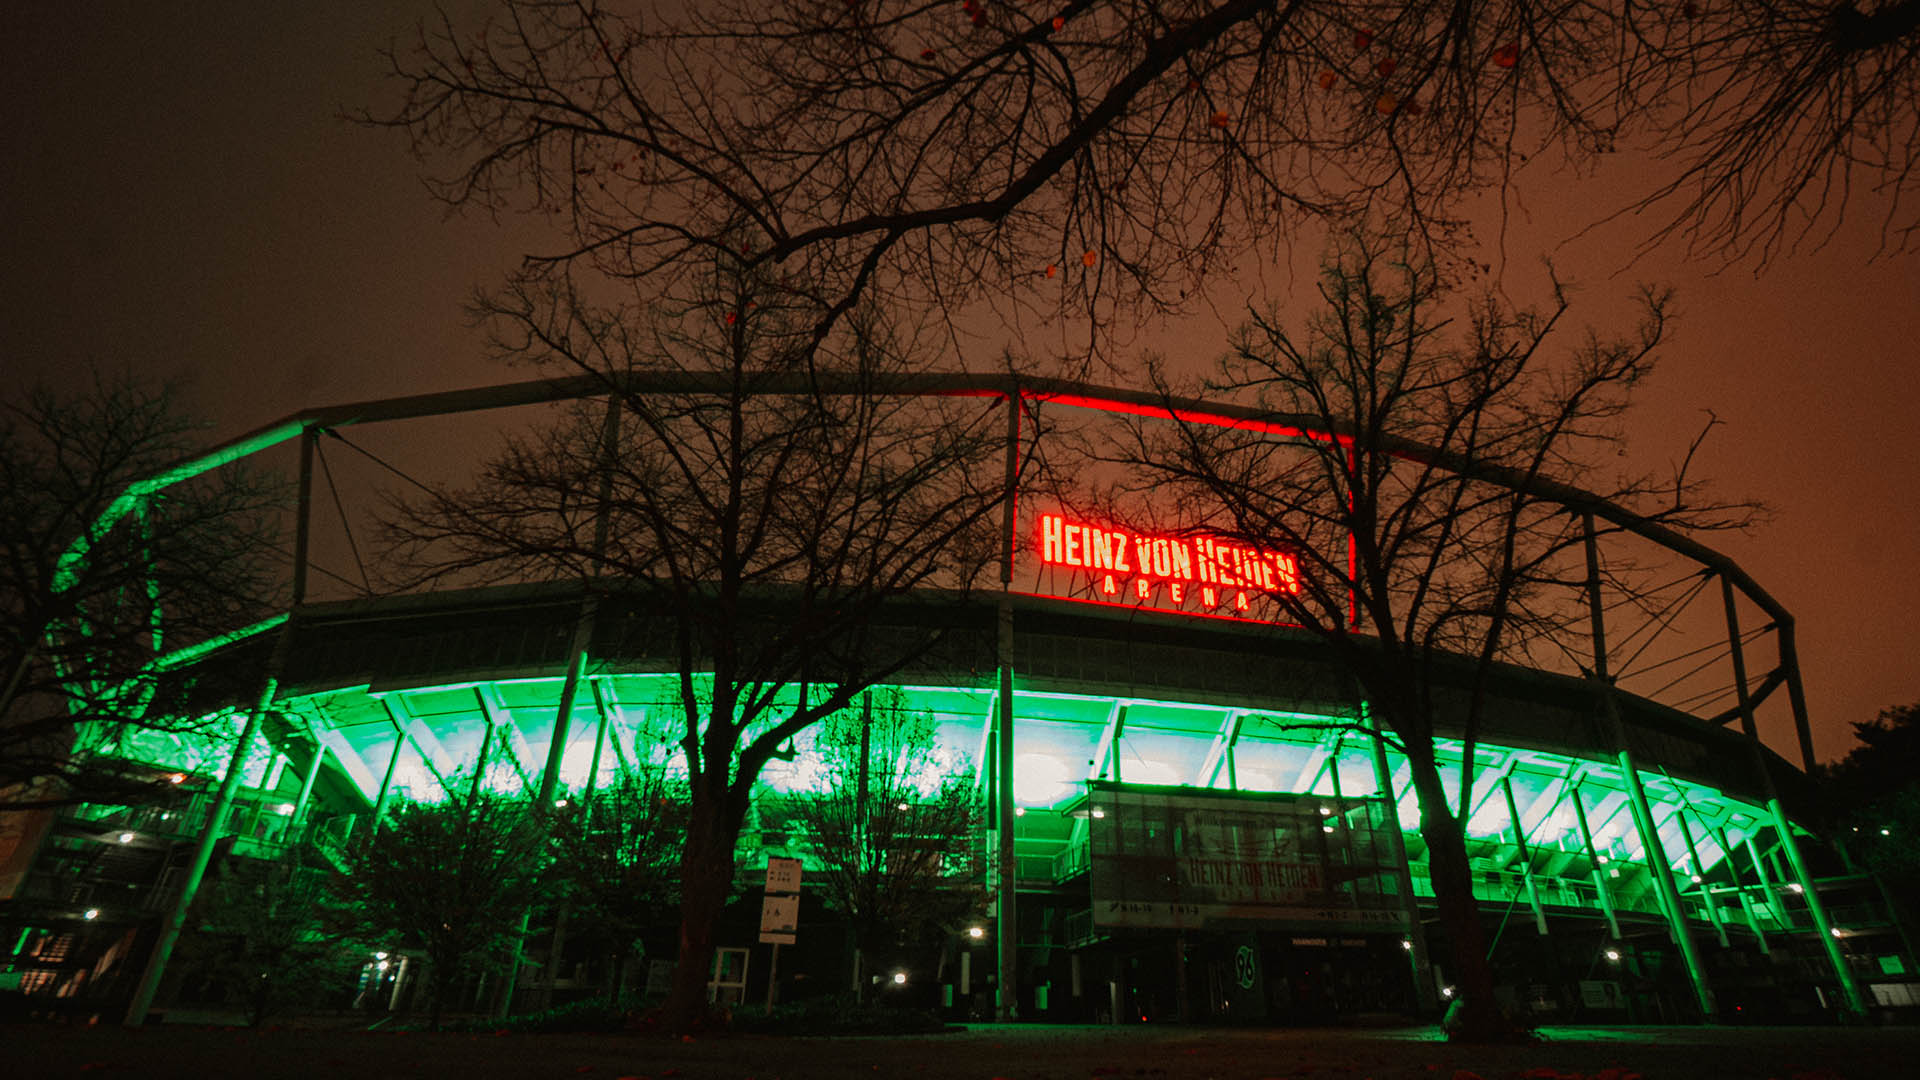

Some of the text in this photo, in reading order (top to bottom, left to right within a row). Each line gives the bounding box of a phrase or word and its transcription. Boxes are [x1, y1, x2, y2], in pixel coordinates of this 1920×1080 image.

[1042, 514, 1299, 594] HEINZ VON HEIDEN
[1103, 574, 1249, 611] ARENA
[1189, 857, 1231, 886] HEINZ
[1266, 861, 1320, 888] HEIDEN
[1234, 945, 1256, 990] 96
